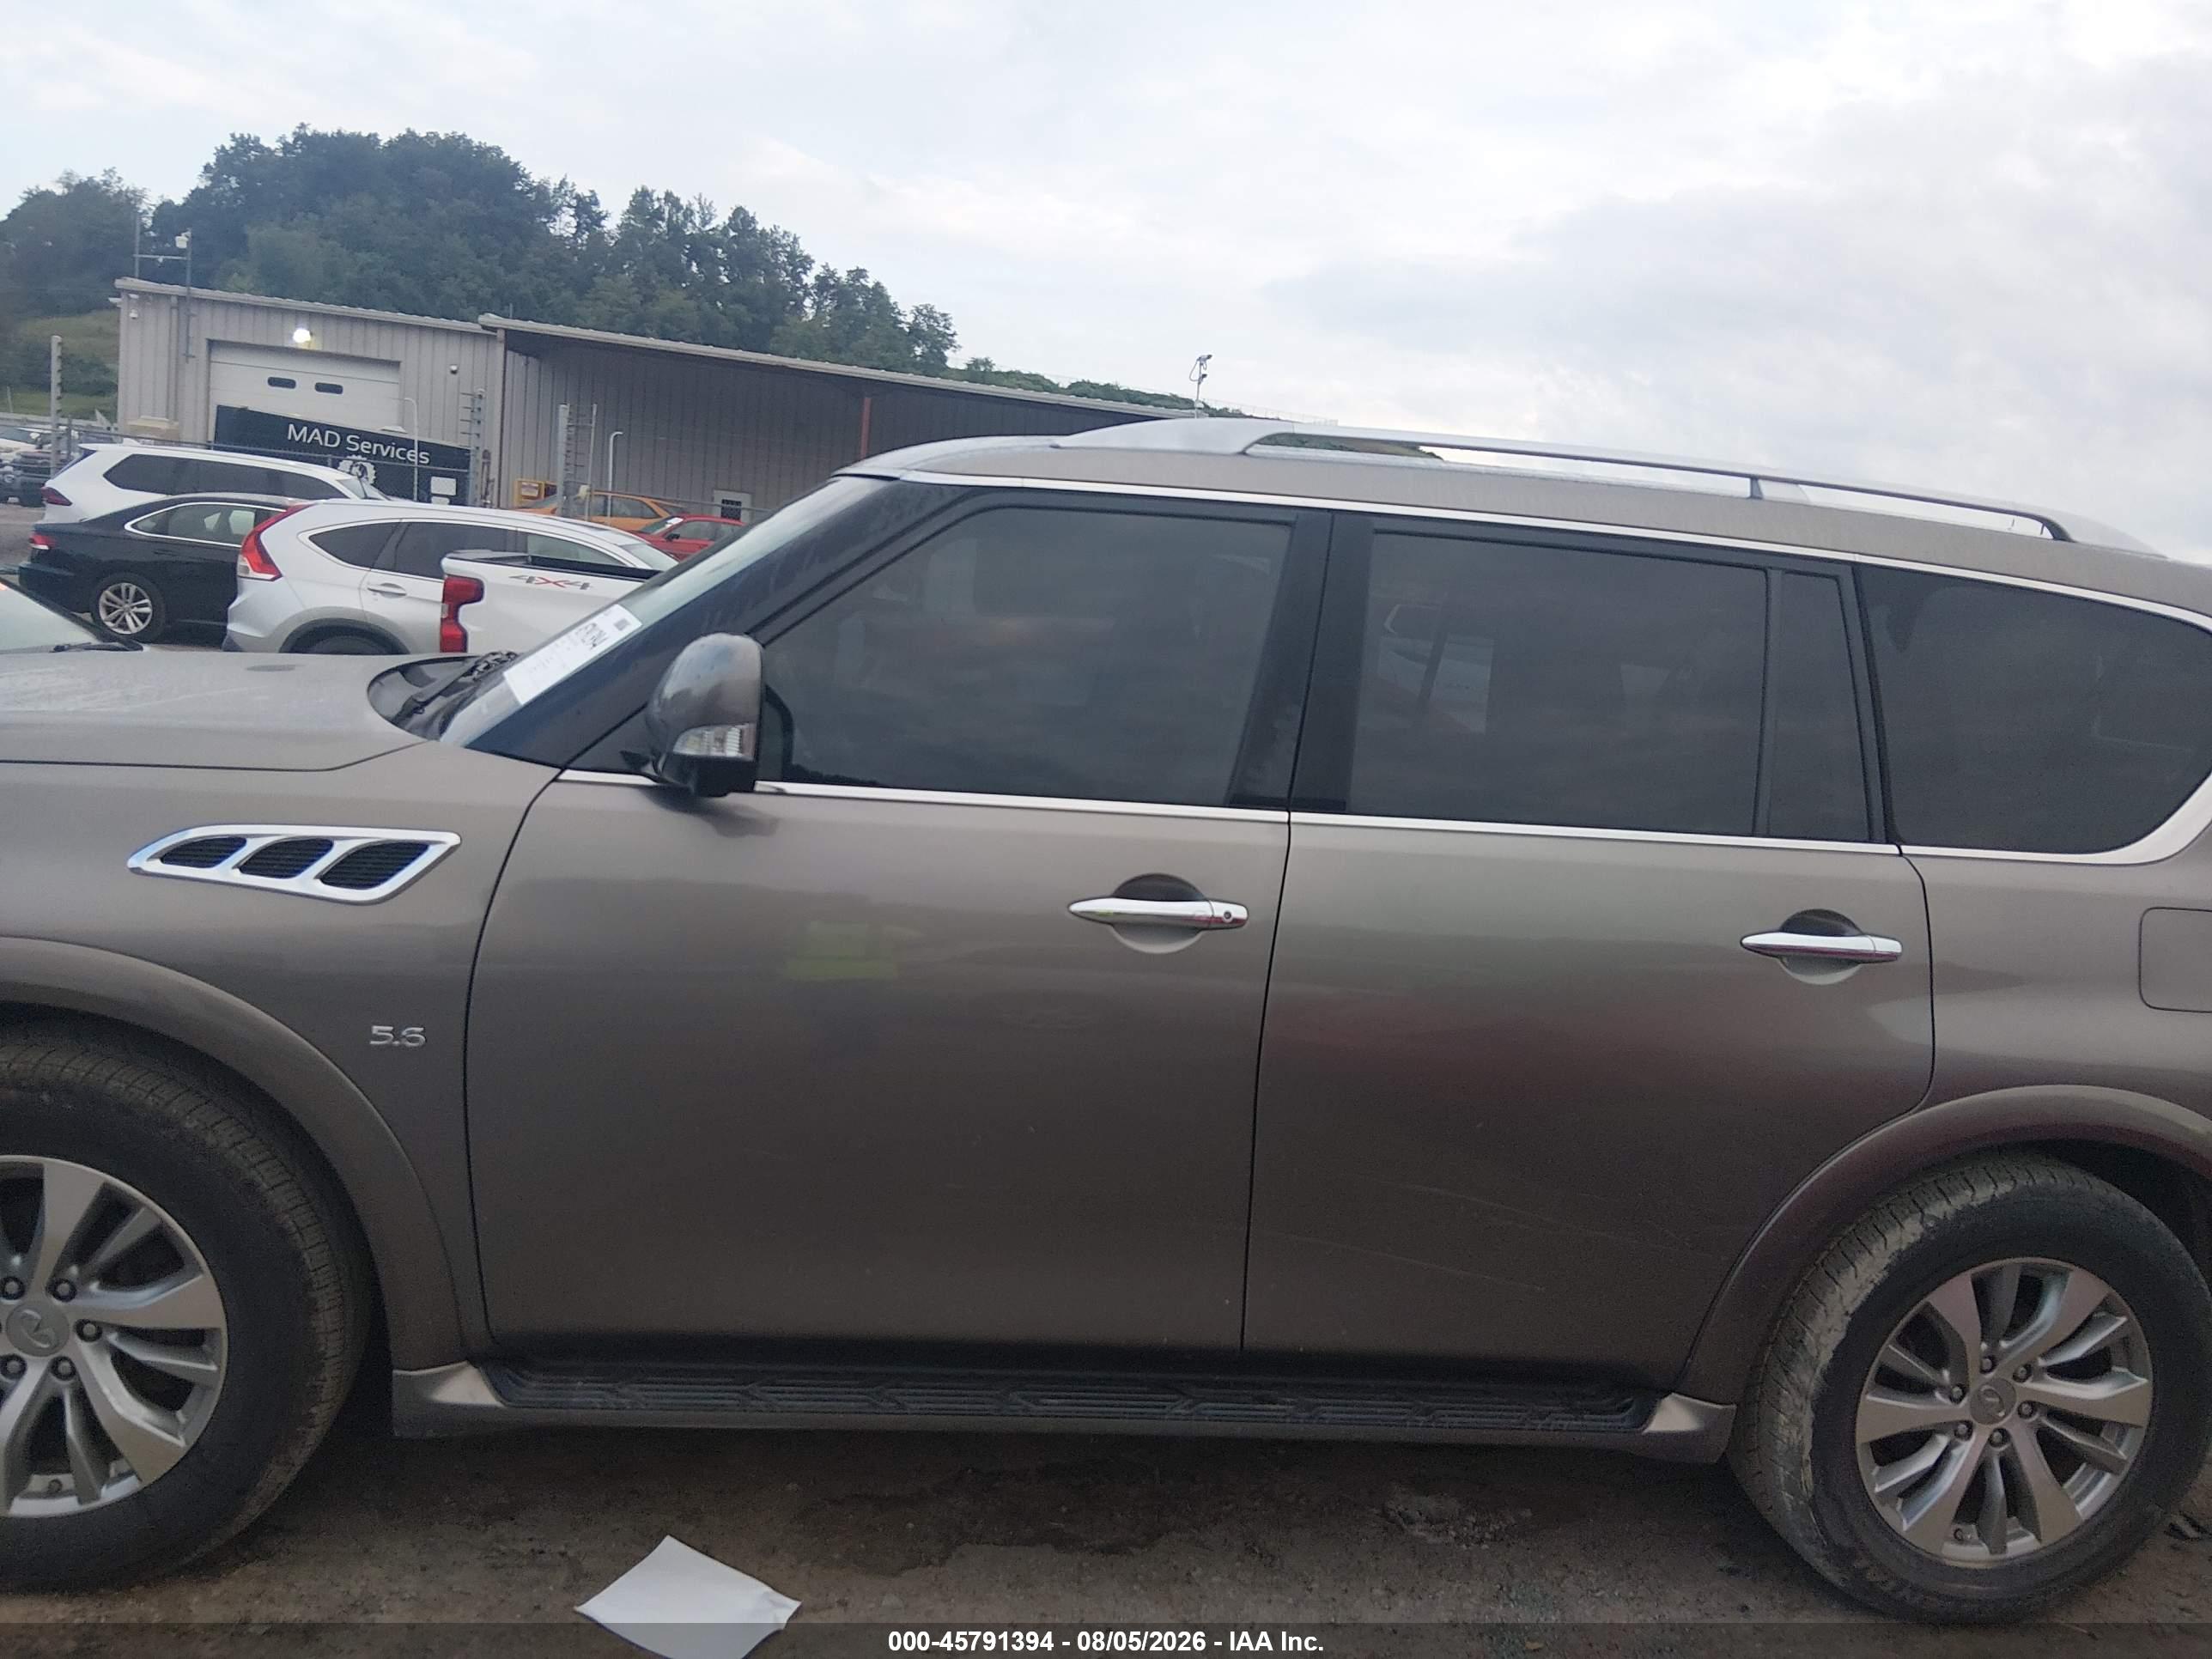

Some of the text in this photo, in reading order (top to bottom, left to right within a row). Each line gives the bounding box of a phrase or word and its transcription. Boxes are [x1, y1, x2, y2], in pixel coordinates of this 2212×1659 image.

[287, 423, 430, 465] MAD Services
[369, 1025, 426, 1047] 5.6
